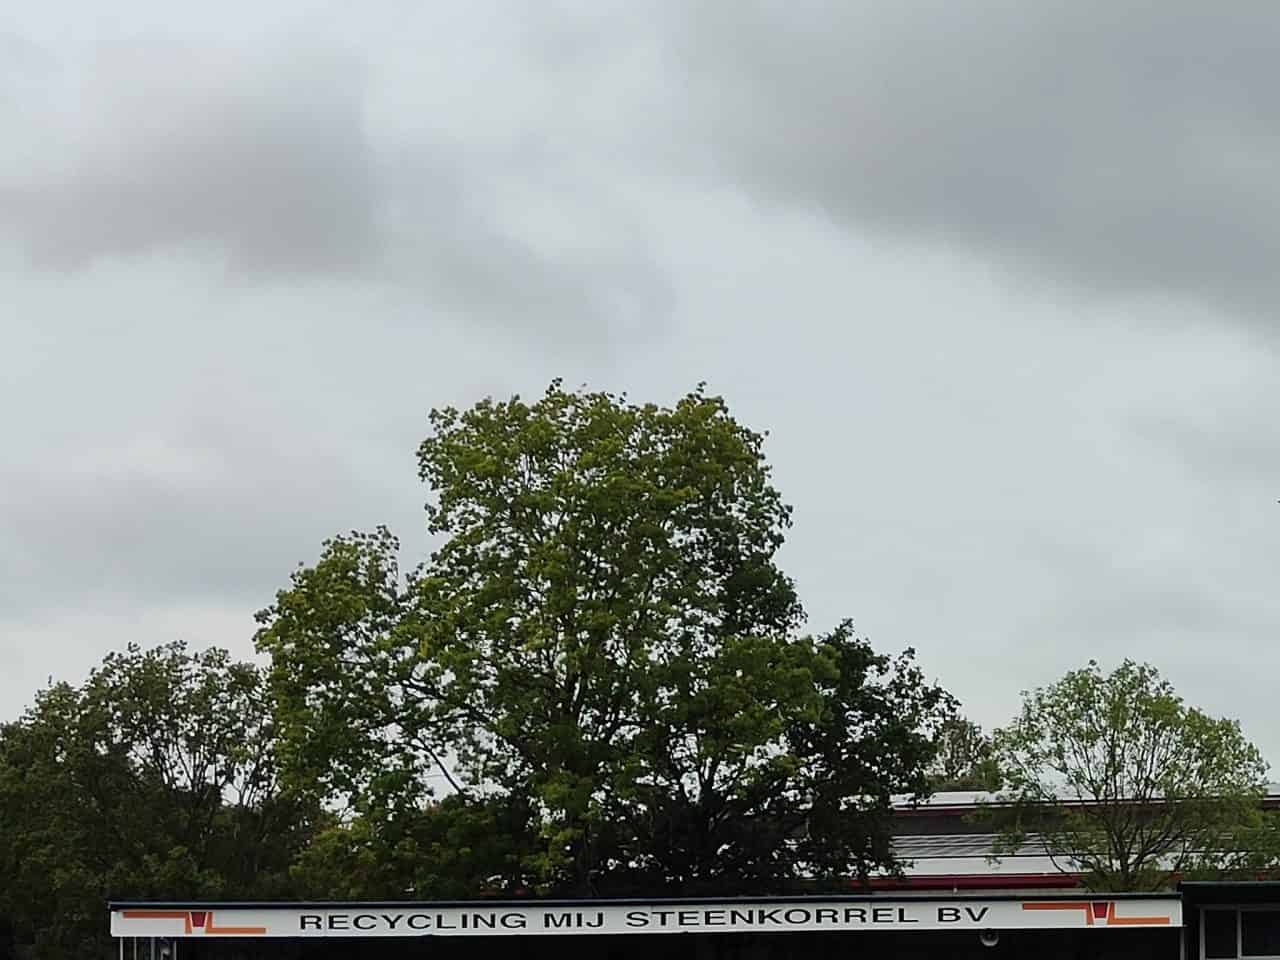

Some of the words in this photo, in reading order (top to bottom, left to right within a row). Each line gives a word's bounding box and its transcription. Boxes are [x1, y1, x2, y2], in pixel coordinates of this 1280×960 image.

[299, 912, 527, 930] RECYCLING
[543, 911, 604, 929] MIJ
[626, 907, 919, 928] STEENKORREL
[937, 906, 989, 923] BV
